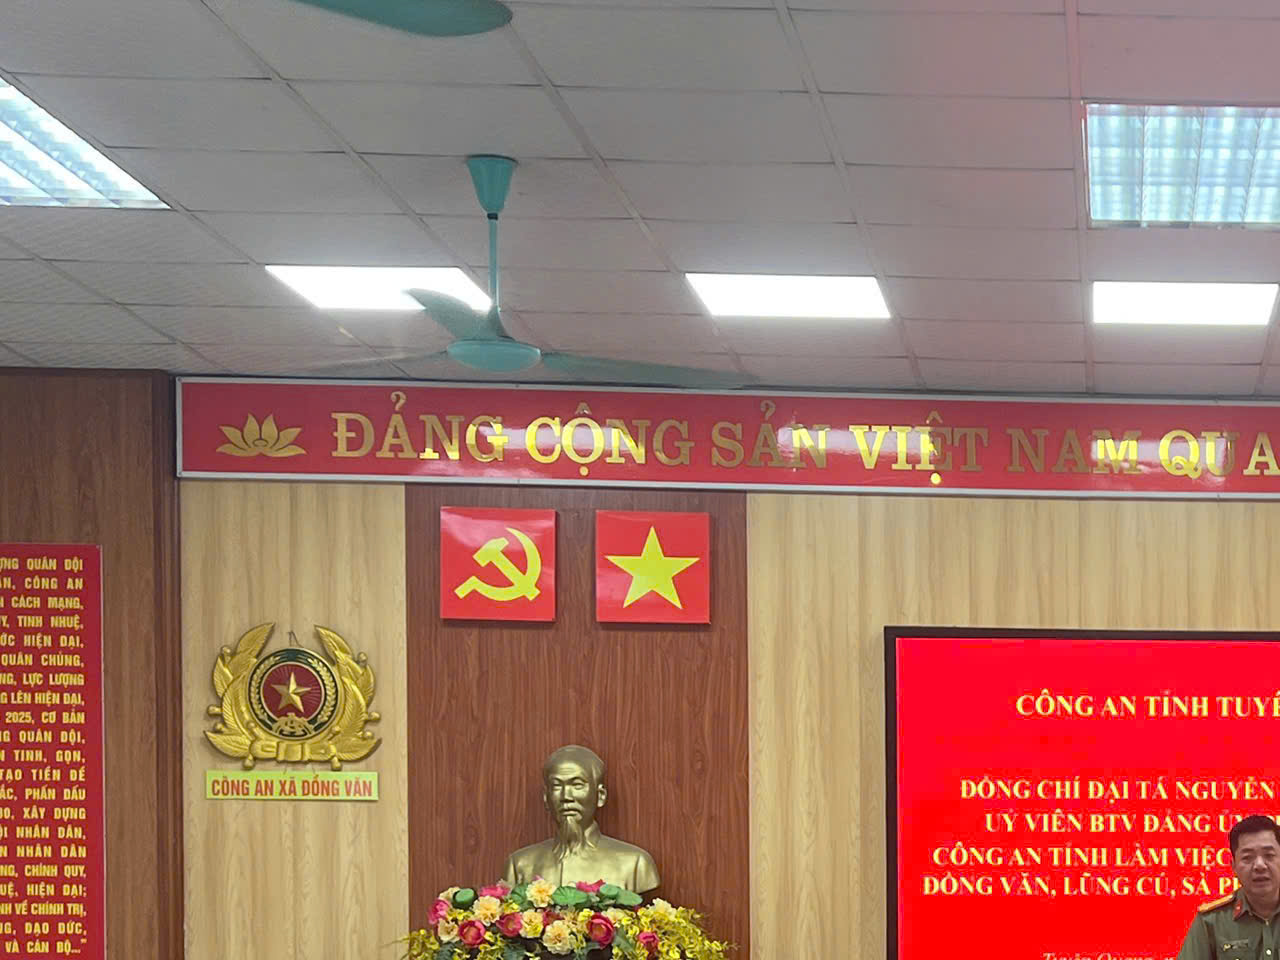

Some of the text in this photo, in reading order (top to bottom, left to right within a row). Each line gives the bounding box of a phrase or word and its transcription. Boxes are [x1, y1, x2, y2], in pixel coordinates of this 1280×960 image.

[332, 391, 510, 461] ĐẢNG
[525, 401, 696, 476] CỘNG
[711, 400, 830, 470] SẢN
[849, 416, 989, 485] VIỆT
[1006, 427, 1141, 475] NAM
[1016, 689, 1093, 716] CÔNG
[1101, 696, 1136, 716] AN
[1145, 690, 1209, 717] TỈNH
[211, 774, 372, 797] CÔNG AN XÃ ĐỒNG VĂN
[961, 775, 1030, 799] ĐỒNG
[1037, 776, 1080, 799] CHÍ
[1088, 780, 1129, 804] ĐẠI
[1136, 776, 1168, 799] TÁ
[1025, 808, 1082, 832] VIÊN
[1090, 814, 1136, 832] BTV
[932, 841, 1003, 865] CÔNG
[1008, 848, 1041, 866] AN
[1048, 842, 1107, 867] TỈNH
[1114, 842, 1169, 866] LÀM
[1175, 844, 1232, 871] VIỆC
[924, 871, 993, 895] ĐỒNG
[1001, 873, 1056, 898] VĂN,
[1063, 873, 1129, 895] LŨNG
